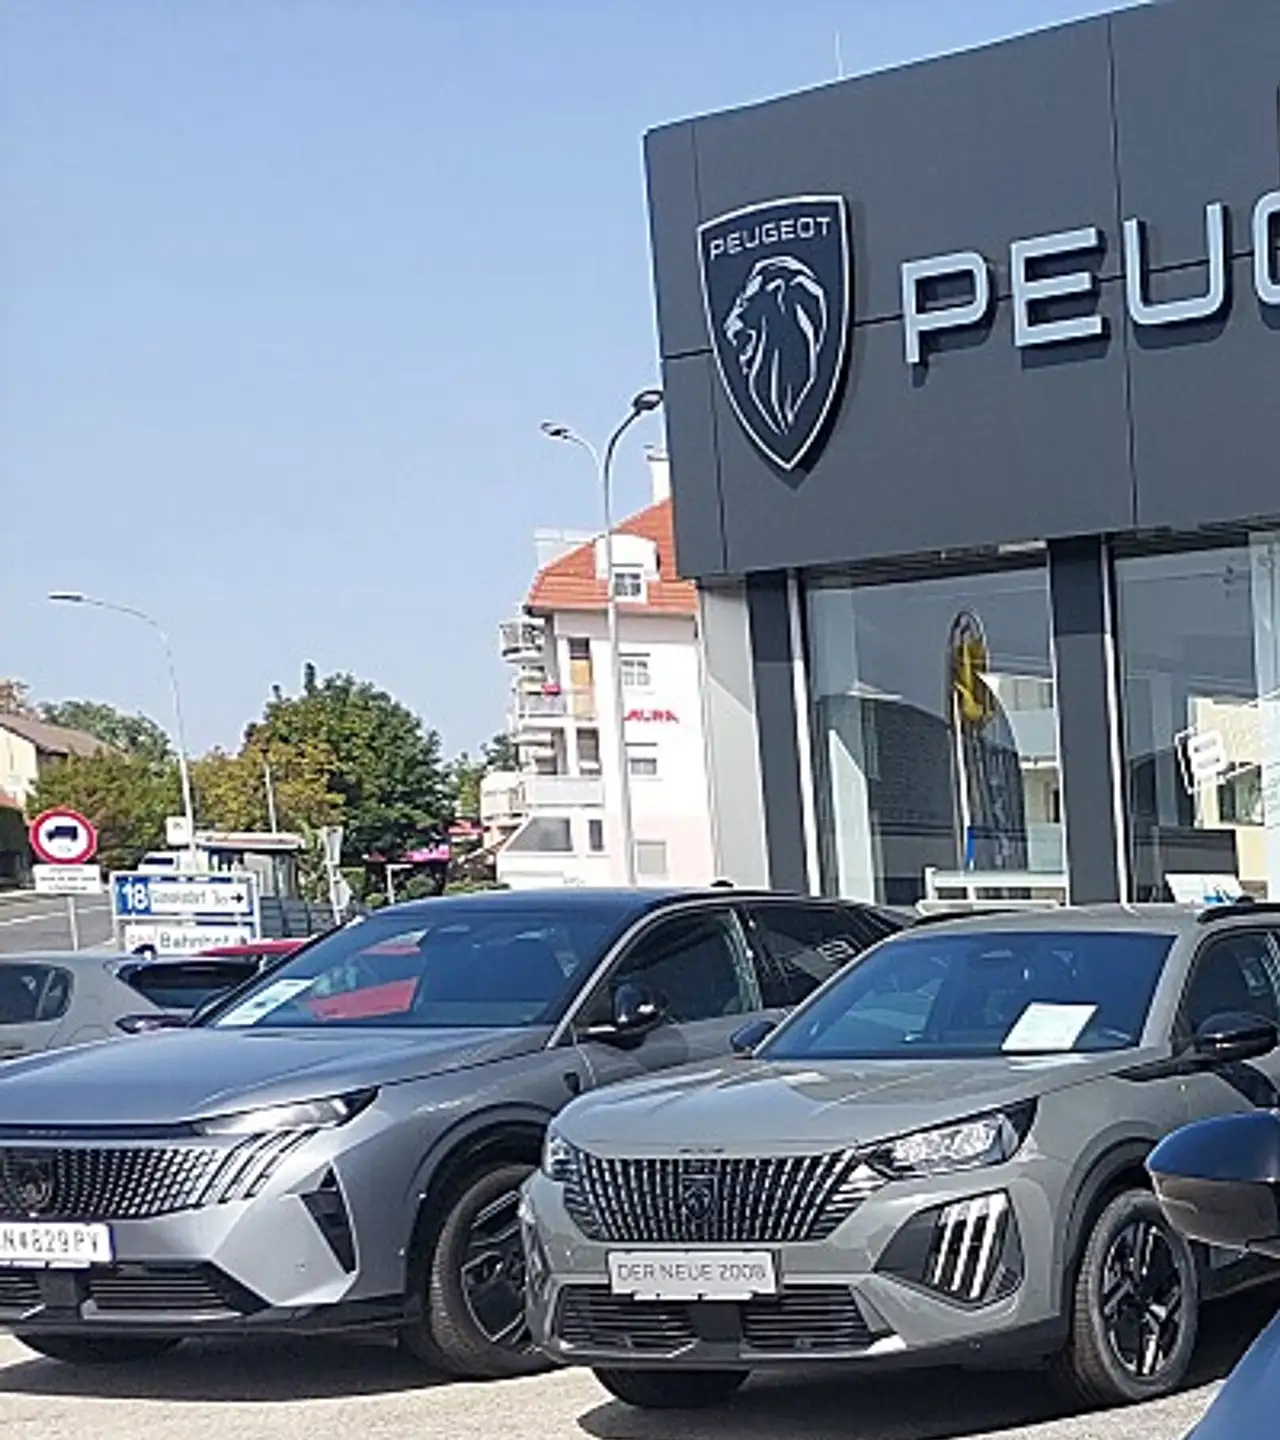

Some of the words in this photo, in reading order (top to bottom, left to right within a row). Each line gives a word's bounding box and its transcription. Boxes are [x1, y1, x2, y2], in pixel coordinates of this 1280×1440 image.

[709, 216, 831, 261] PEUGEOT
[121, 883, 149, 910] 18
[617, 1263, 654, 1281] DER
[660, 1263, 712, 1281] NEUE
